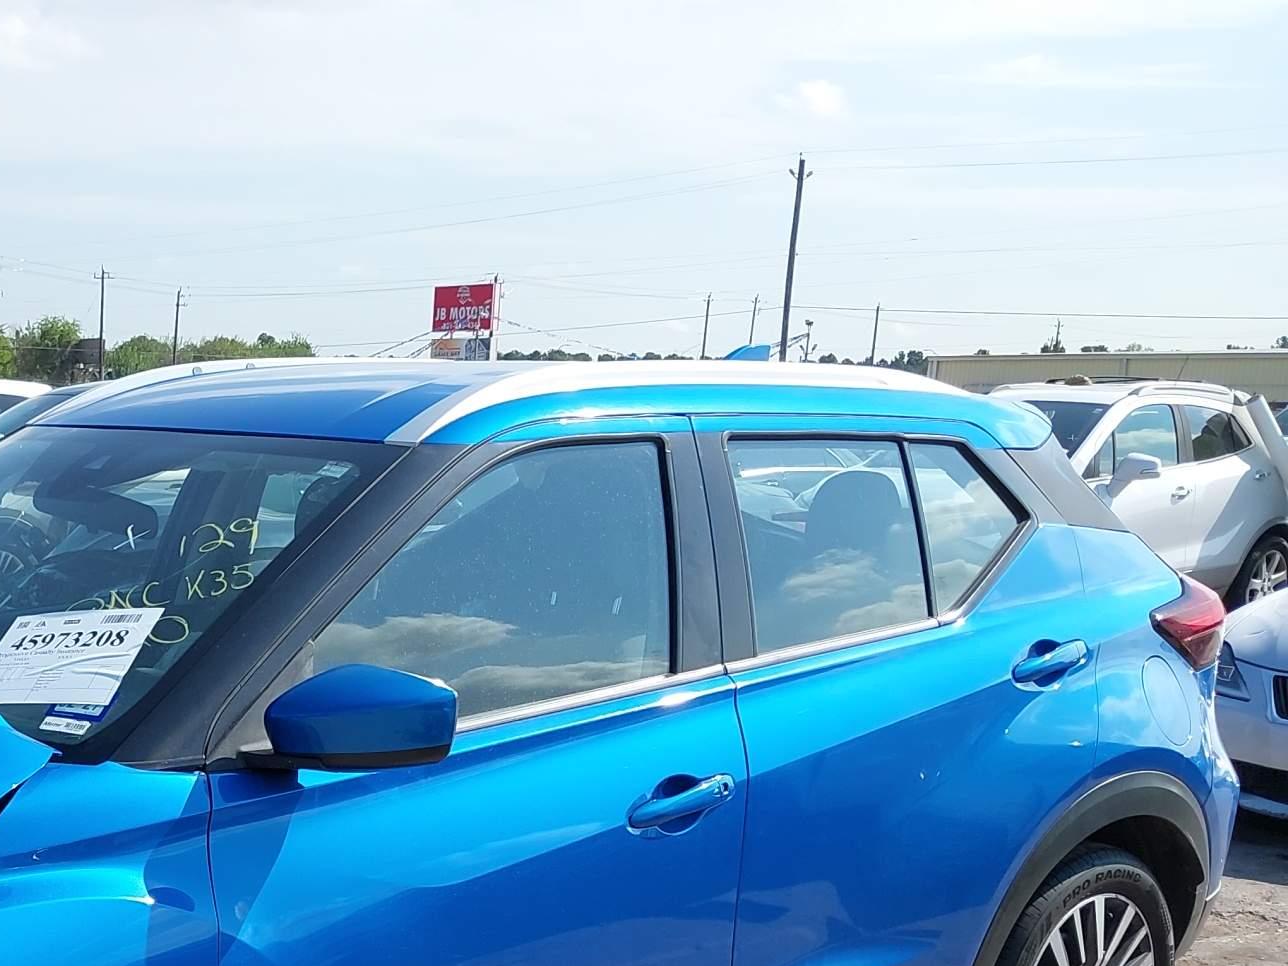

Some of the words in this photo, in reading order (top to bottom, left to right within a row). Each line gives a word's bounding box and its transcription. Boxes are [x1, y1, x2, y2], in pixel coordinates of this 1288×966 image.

[435, 307, 447, 321] JB
[449, 305, 491, 321] MOTORS
[179, 517, 260, 557] 129
[185, 563, 255, 600] K35
[11, 629, 130, 651] 45973208
[1062, 879, 1092, 909] PRO
[1094, 868, 1143, 884] RACING
